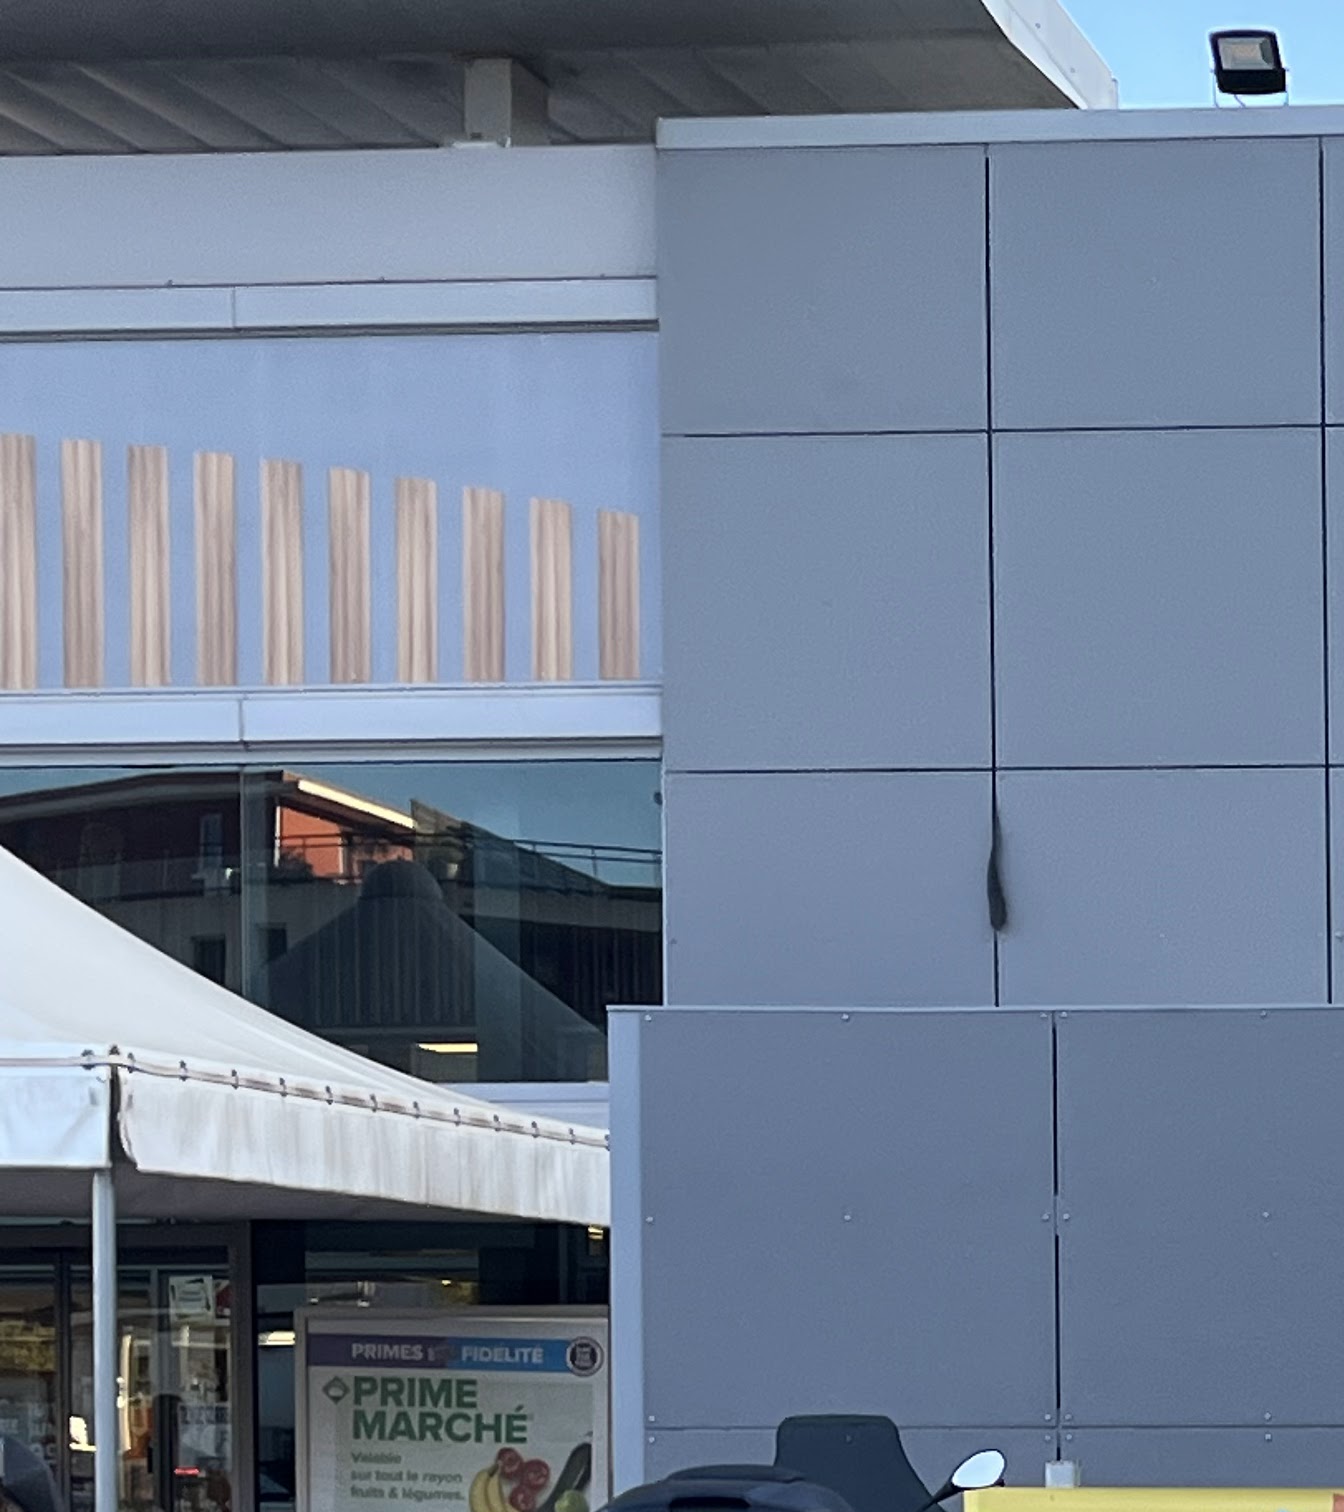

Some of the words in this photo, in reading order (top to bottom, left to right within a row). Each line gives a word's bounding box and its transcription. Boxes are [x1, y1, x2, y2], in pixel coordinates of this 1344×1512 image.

[353, 1376, 478, 1408] PRIME
[352, 1405, 528, 1443] MARCHÉ
[422, 1472, 463, 1484] rayon
